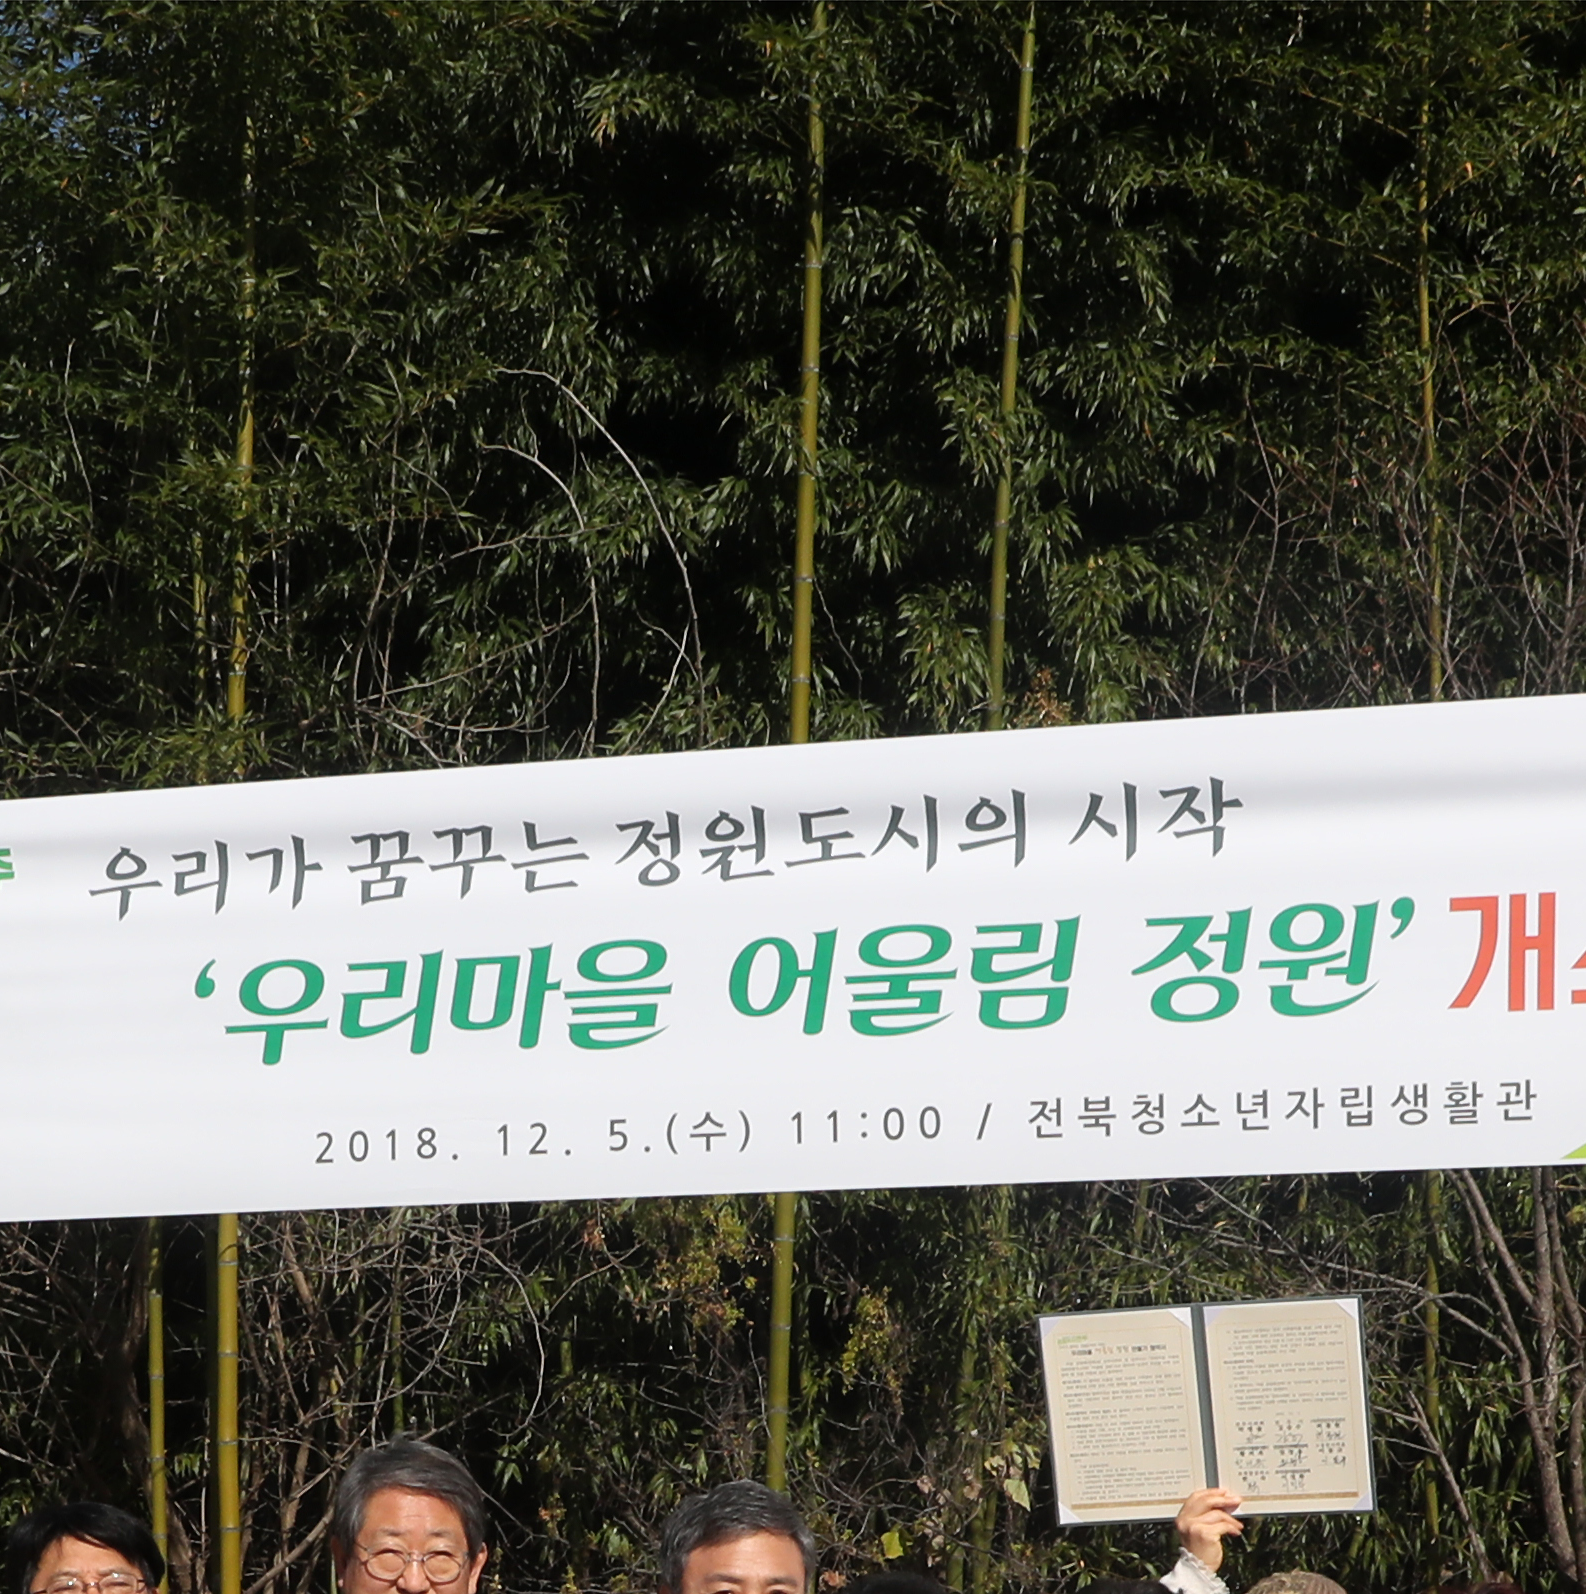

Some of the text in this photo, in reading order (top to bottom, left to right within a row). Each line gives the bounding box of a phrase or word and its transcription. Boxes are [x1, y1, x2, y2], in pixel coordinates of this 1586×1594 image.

[88, 775, 1244, 921] 우리가 꿈꾸는 정원도시의 시작
[728, 916, 1080, 1037] 어울림
[315, 1127, 459, 1165] 2018.
[497, 1121, 572, 1156] 12.
[608, 1109, 751, 1156] 5.(수)
[790, 1105, 942, 1145] 11:00
[1028, 1078, 1538, 1140] 전북청소년자립생활관
